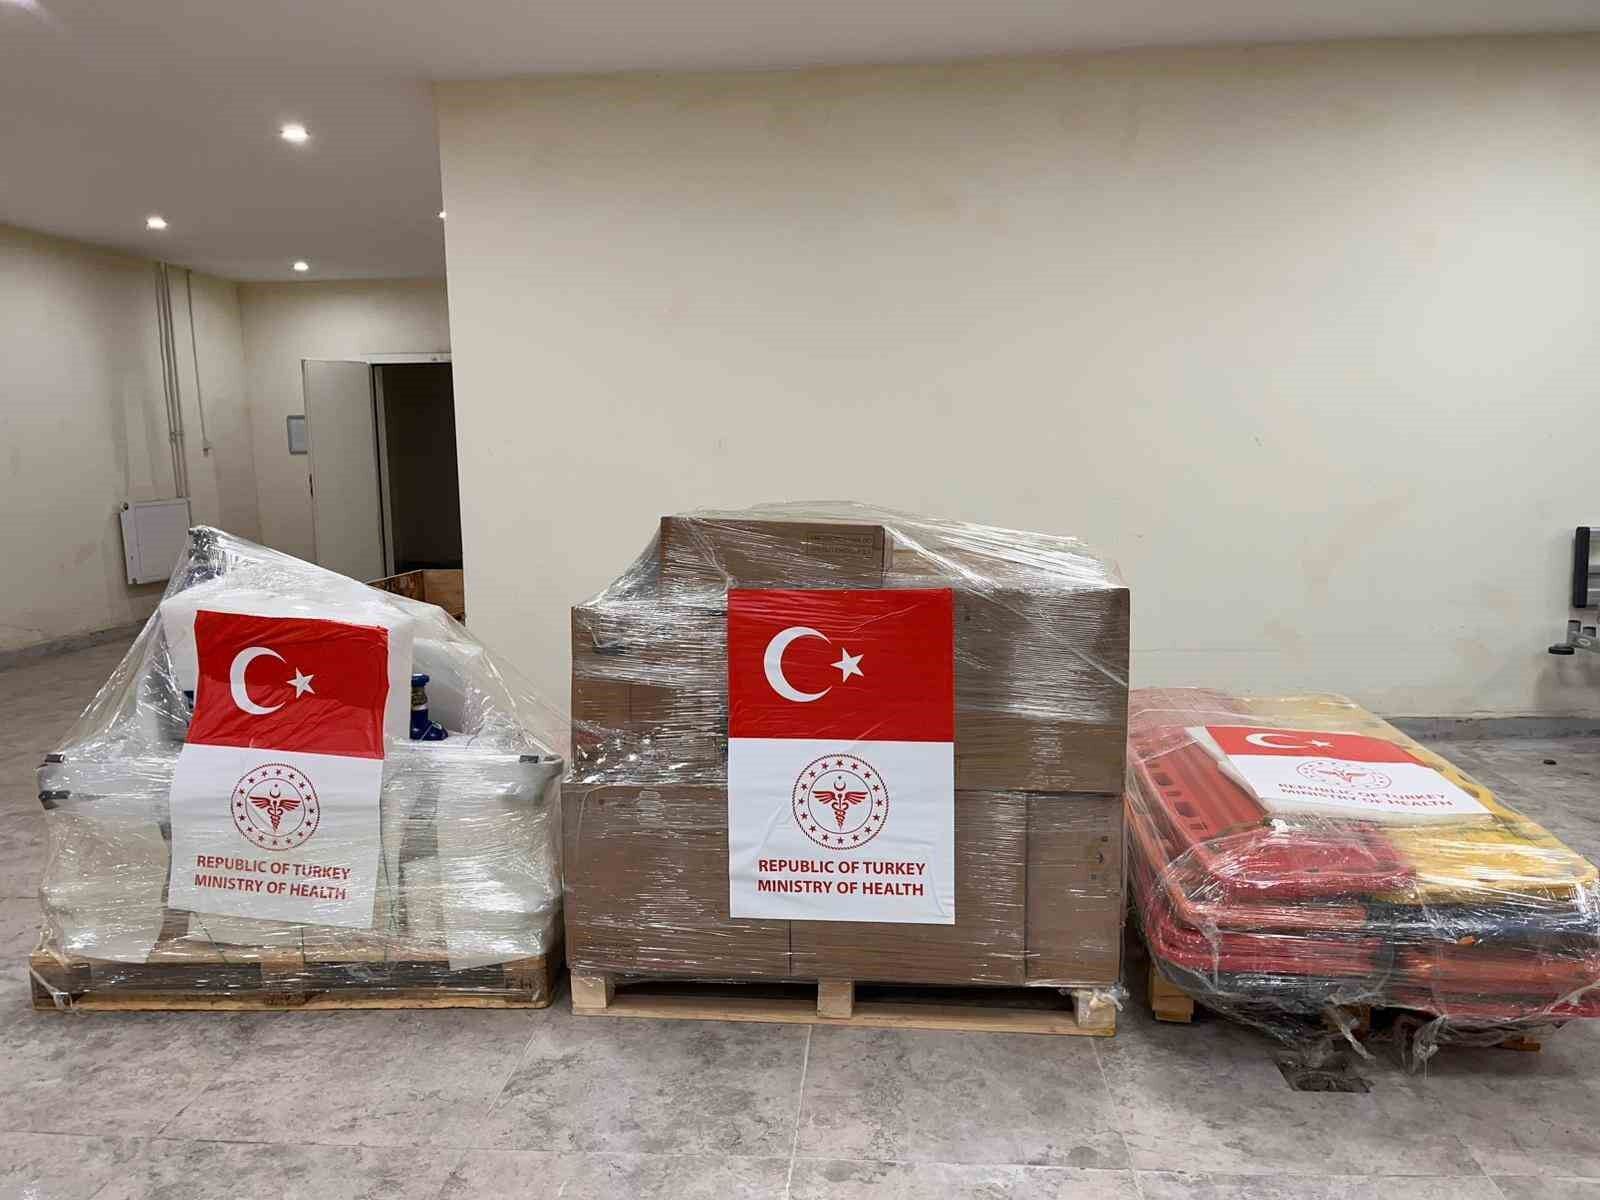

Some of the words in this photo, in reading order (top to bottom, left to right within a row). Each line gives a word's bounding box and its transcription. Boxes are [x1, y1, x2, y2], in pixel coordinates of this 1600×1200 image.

[197, 855, 267, 873] REPUBLIC
[270, 862, 290, 875] OF
[293, 864, 351, 880] TURKEY
[758, 859, 834, 874] REPUBLIC
[838, 861, 859, 874] OF
[863, 861, 926, 876] TURKEY
[194, 874, 263, 893] MINISTRY
[266, 881, 287, 894] OF
[290, 884, 346, 900] HEALTH
[758, 879, 832, 894] MINISTRY
[836, 881, 858, 894] OF
[862, 882, 924, 896] HEALTH
